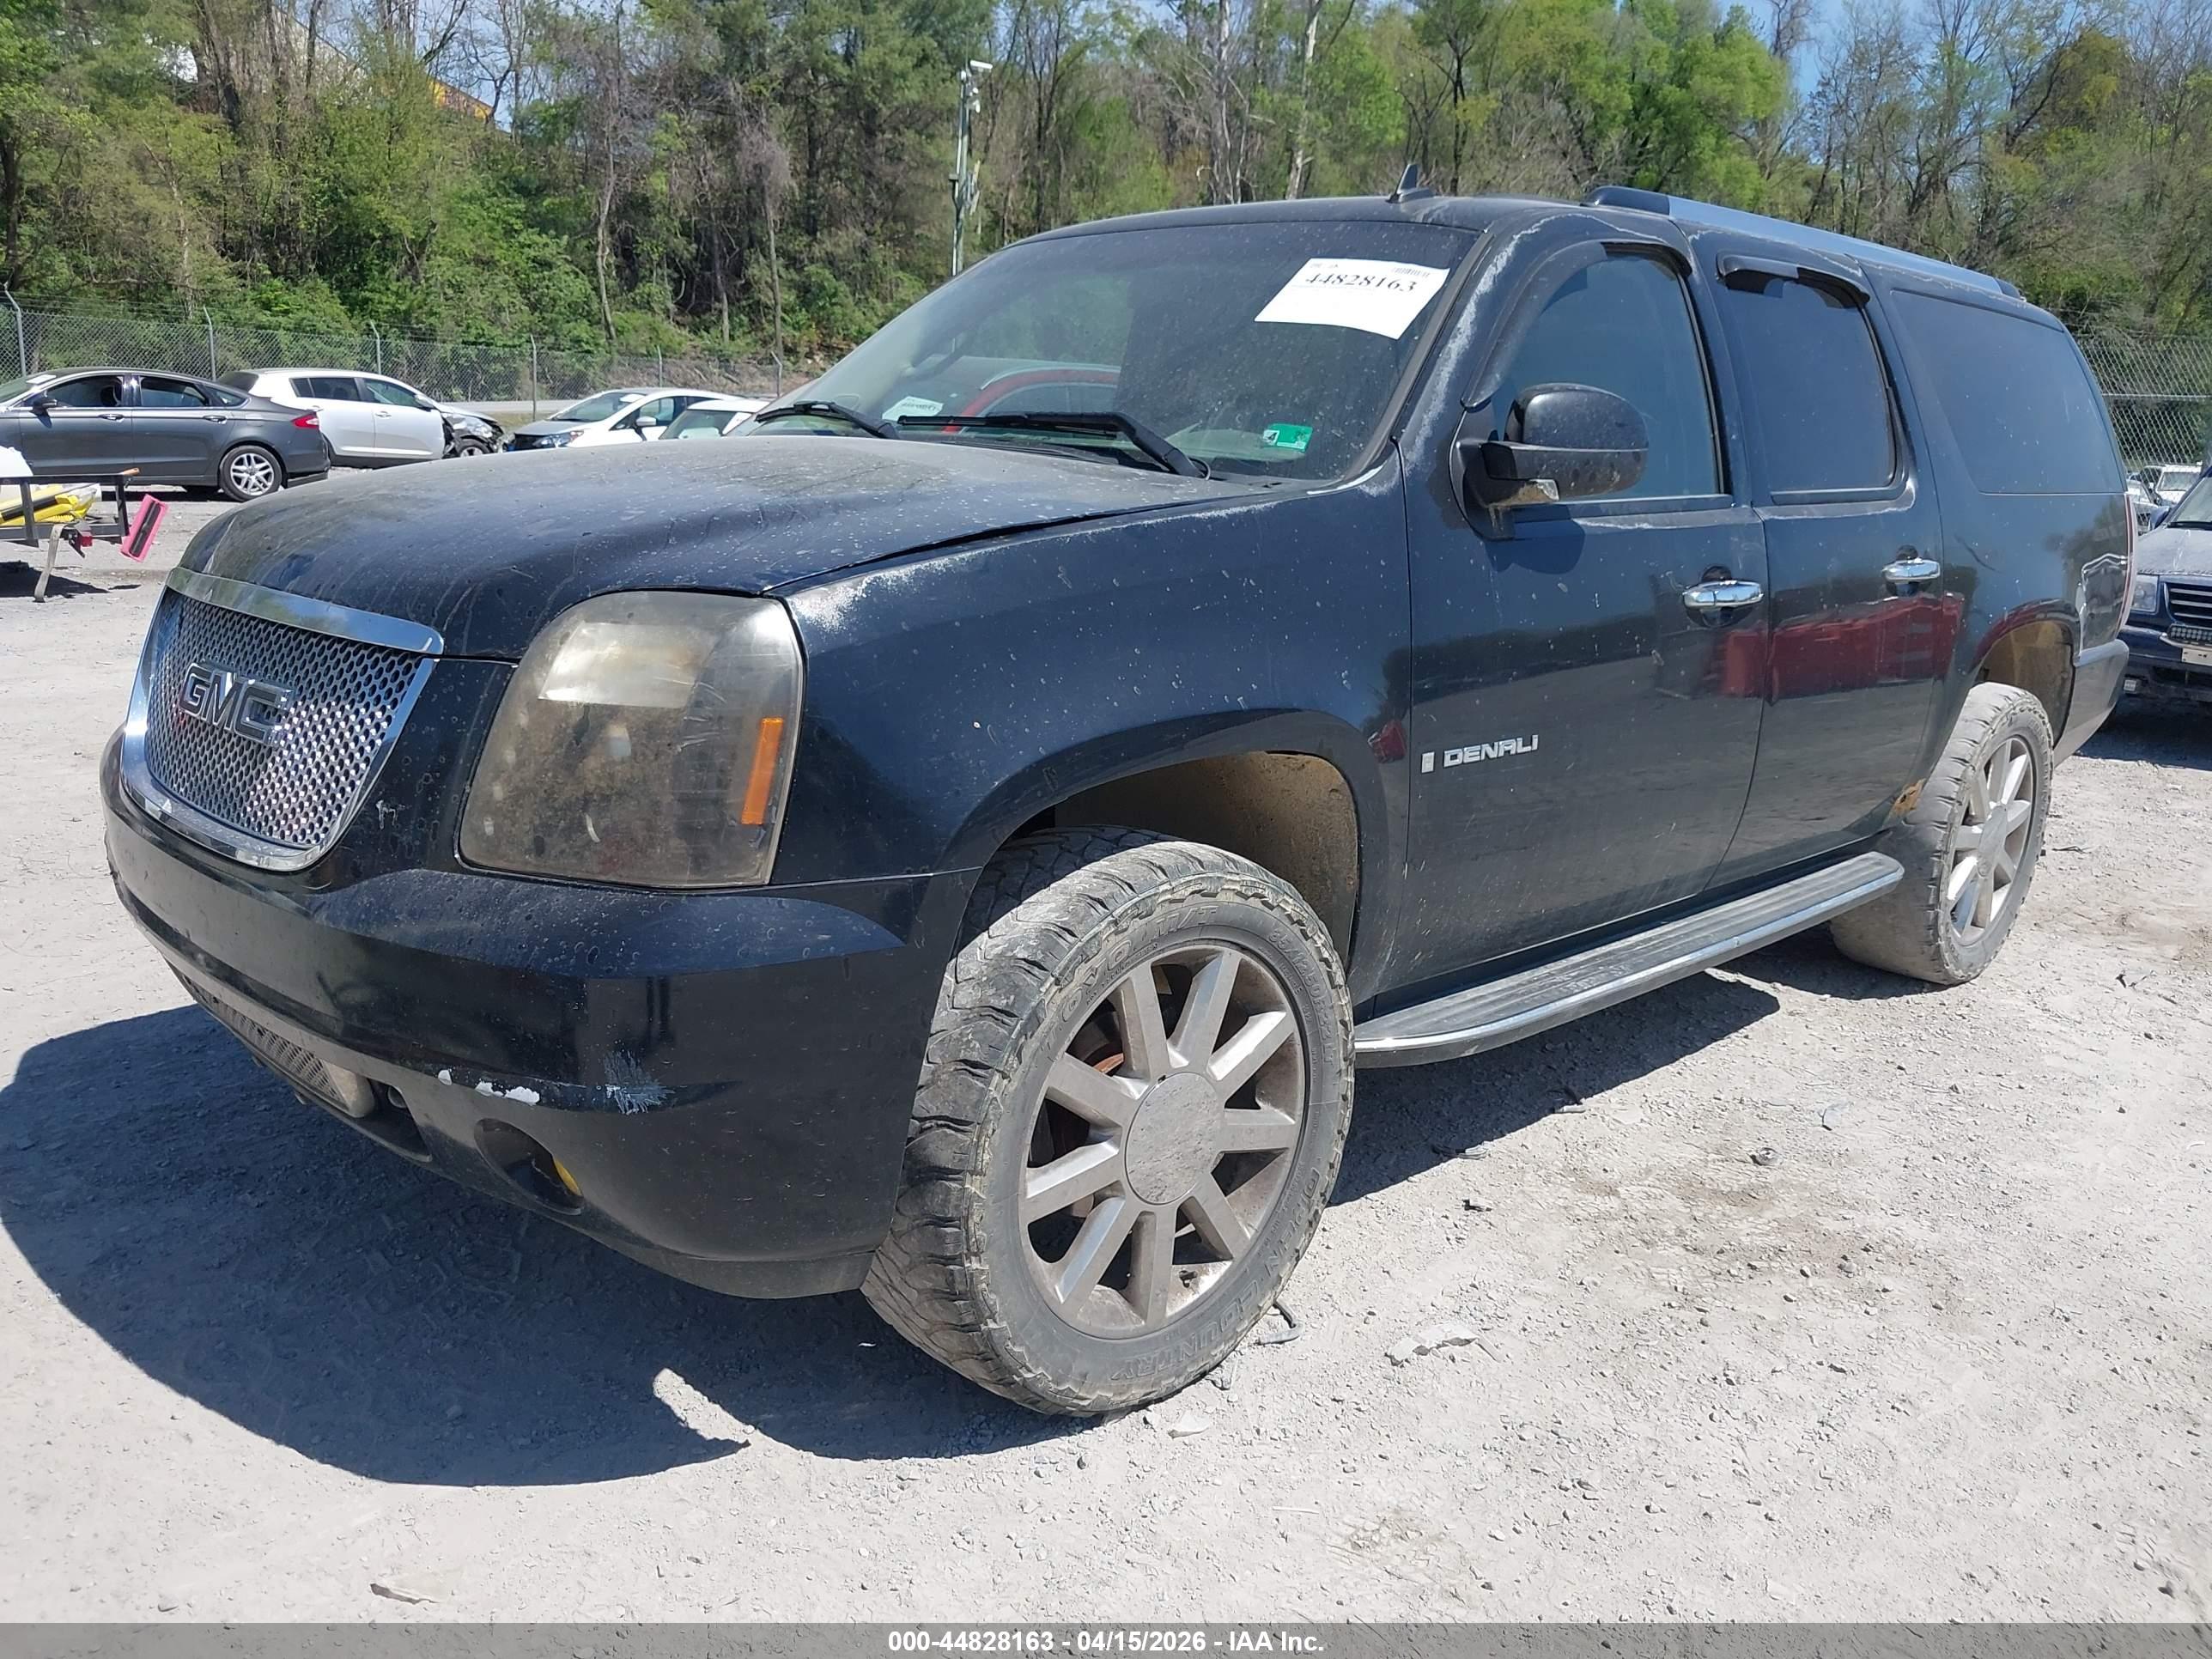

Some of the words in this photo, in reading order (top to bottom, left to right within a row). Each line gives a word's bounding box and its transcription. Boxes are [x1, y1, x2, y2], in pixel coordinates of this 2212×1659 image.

[1306, 273, 1418, 292] 44828163
[179, 663, 288, 746] GMC
[1443, 734, 1539, 765] DENALI
